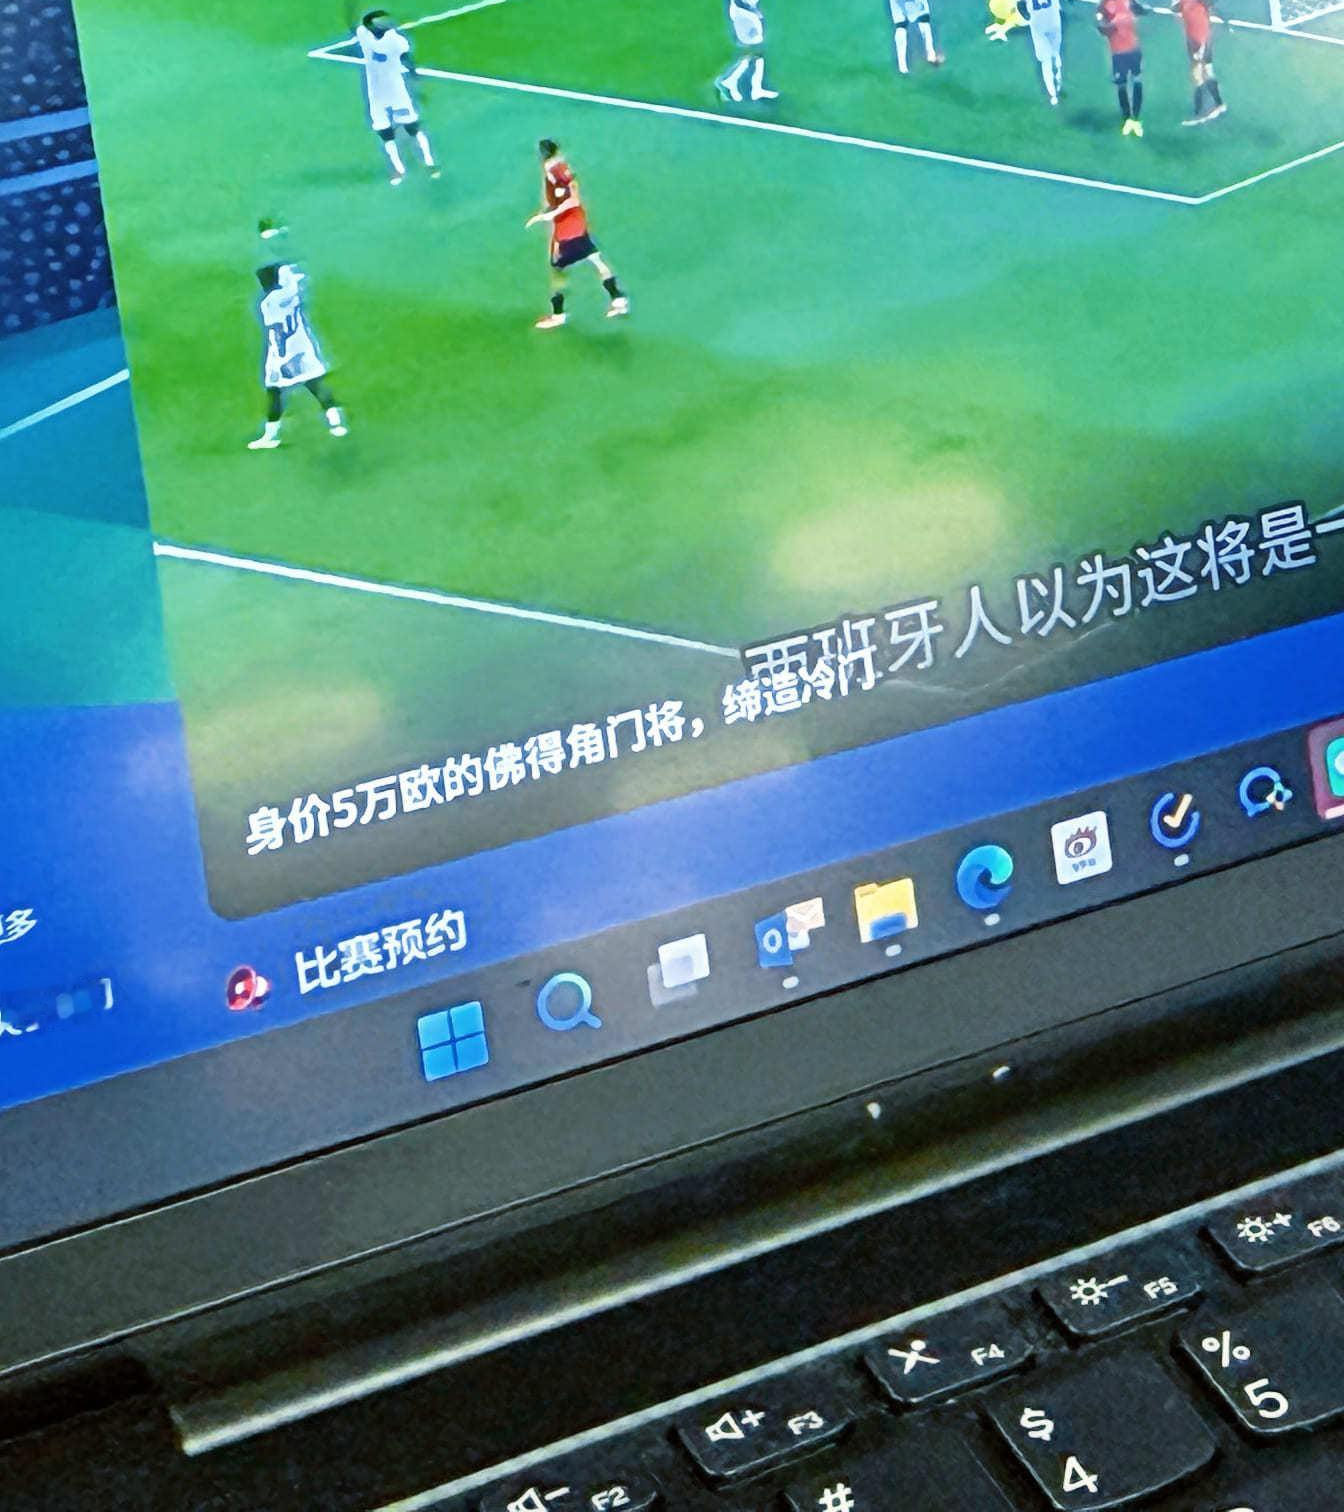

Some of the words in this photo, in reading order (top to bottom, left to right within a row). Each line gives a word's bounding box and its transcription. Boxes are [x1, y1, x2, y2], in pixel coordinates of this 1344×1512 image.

[295, 908, 467, 994] 比赛预约
[1306, 1215, 1341, 1238] F6
[1143, 1276, 1178, 1300] F5
[970, 1343, 1005, 1366] F4
[1200, 1330, 1251, 1368] %
[1243, 1378, 1289, 1420] 5
[1019, 1407, 1055, 1442] $
[1062, 1455, 1098, 1493] 4
[591, 1486, 631, 1512] F2
